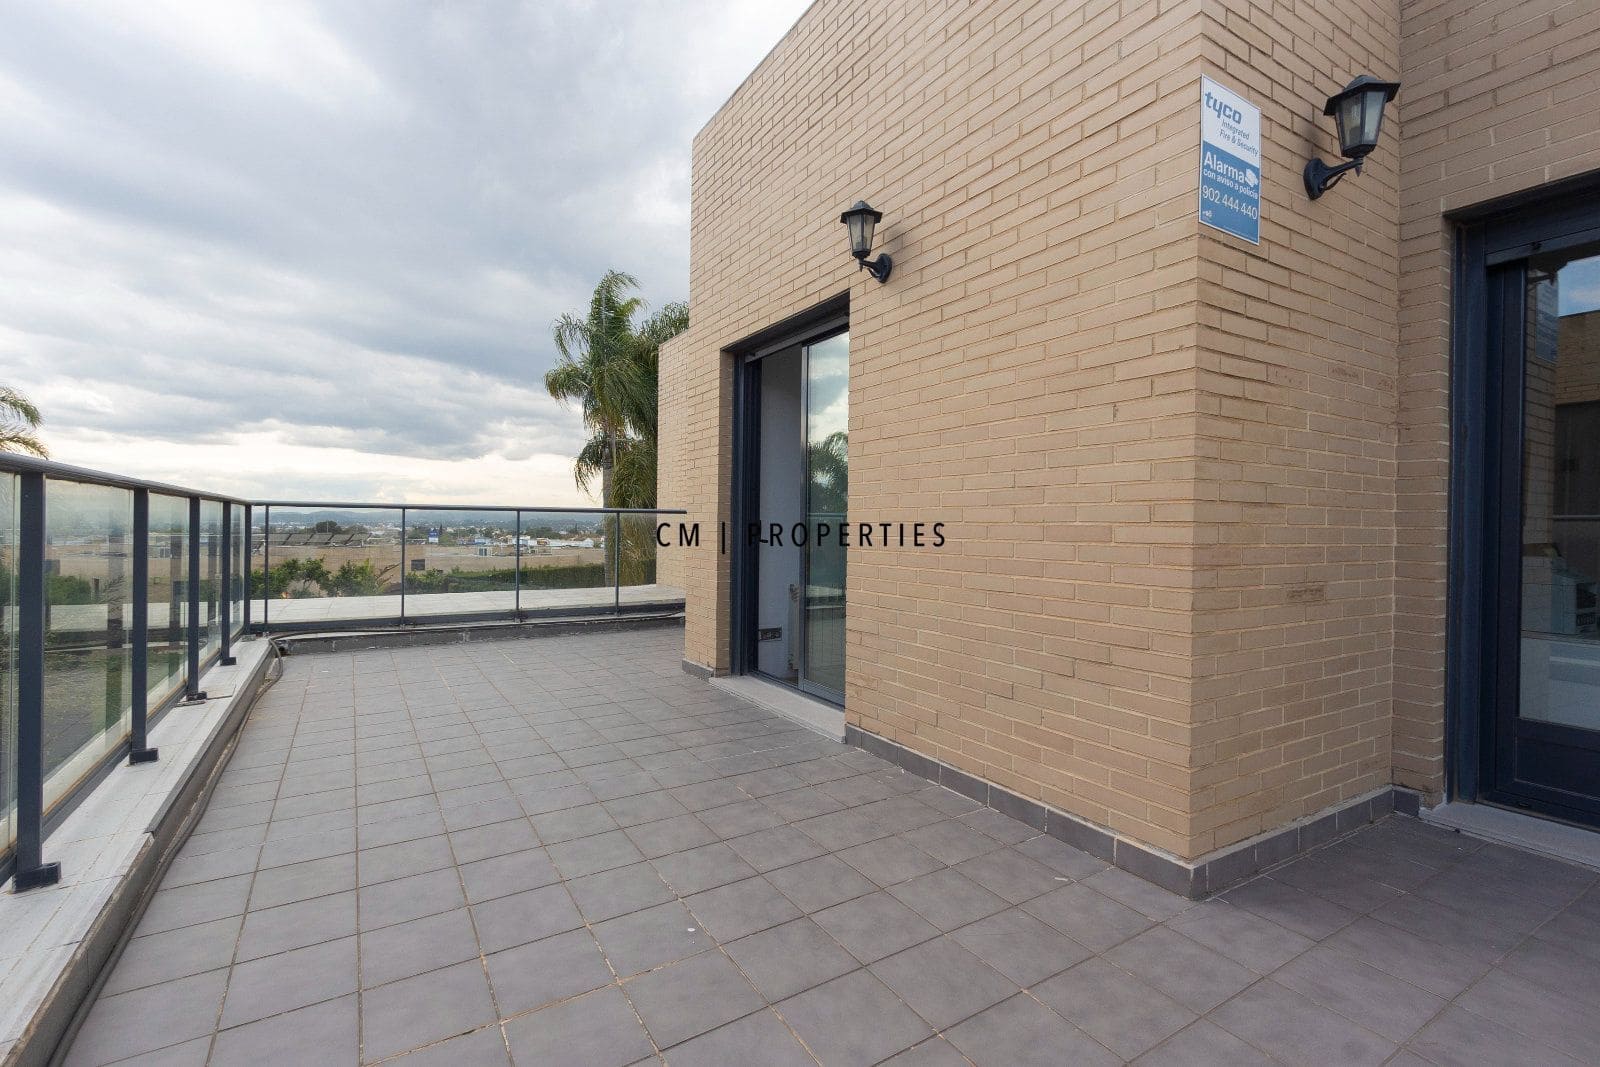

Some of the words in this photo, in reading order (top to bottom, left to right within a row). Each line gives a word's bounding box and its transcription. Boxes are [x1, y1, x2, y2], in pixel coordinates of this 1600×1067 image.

[1205, 91, 1242, 125] tyco
[1219, 128, 1231, 141] Fire
[1237, 137, 1259, 157] Security
[1221, 119, 1250, 140] Integrated
[1203, 151, 1245, 184] Alarma
[1203, 168, 1216, 180] con
[1216, 174, 1234, 188] aviso
[1202, 185, 1221, 204] 902
[1222, 193, 1240, 213] 444
[1240, 202, 1258, 220] 440
